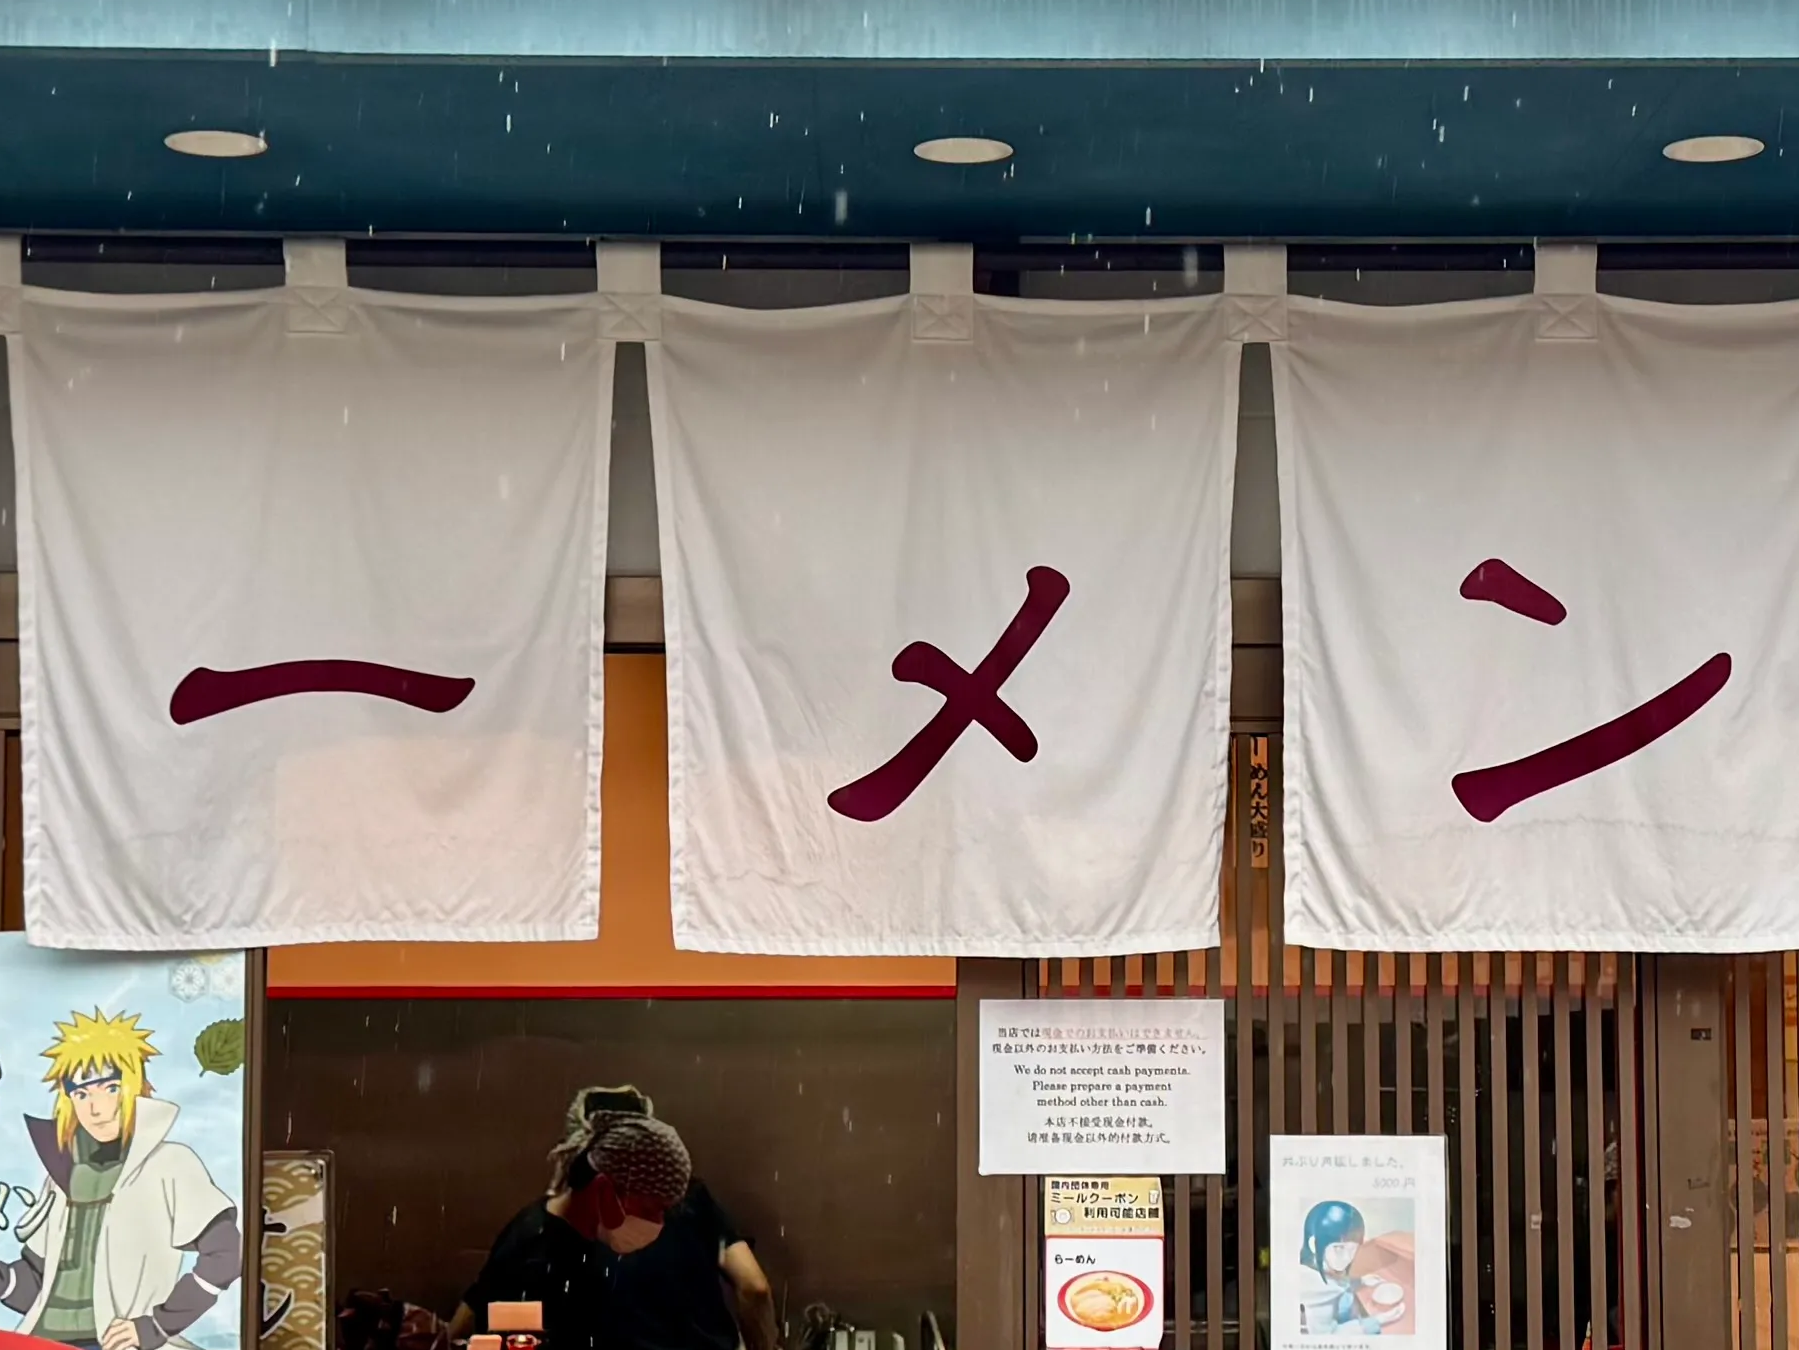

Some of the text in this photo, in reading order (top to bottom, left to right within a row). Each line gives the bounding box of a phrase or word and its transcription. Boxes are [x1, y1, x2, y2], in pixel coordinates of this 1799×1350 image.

[1014, 1065, 1190, 1077] We do not accept cash payments.
[1032, 1081, 1067, 1091] Please
[1070, 1082, 1112, 1093] prepare
[1125, 1082, 1171, 1093] payment
[1037, 1096, 1167, 1106] method other than cash.
[1051, 1192, 1139, 1204] ミールクーポン
[1054, 1254, 1096, 1265] らーめん
